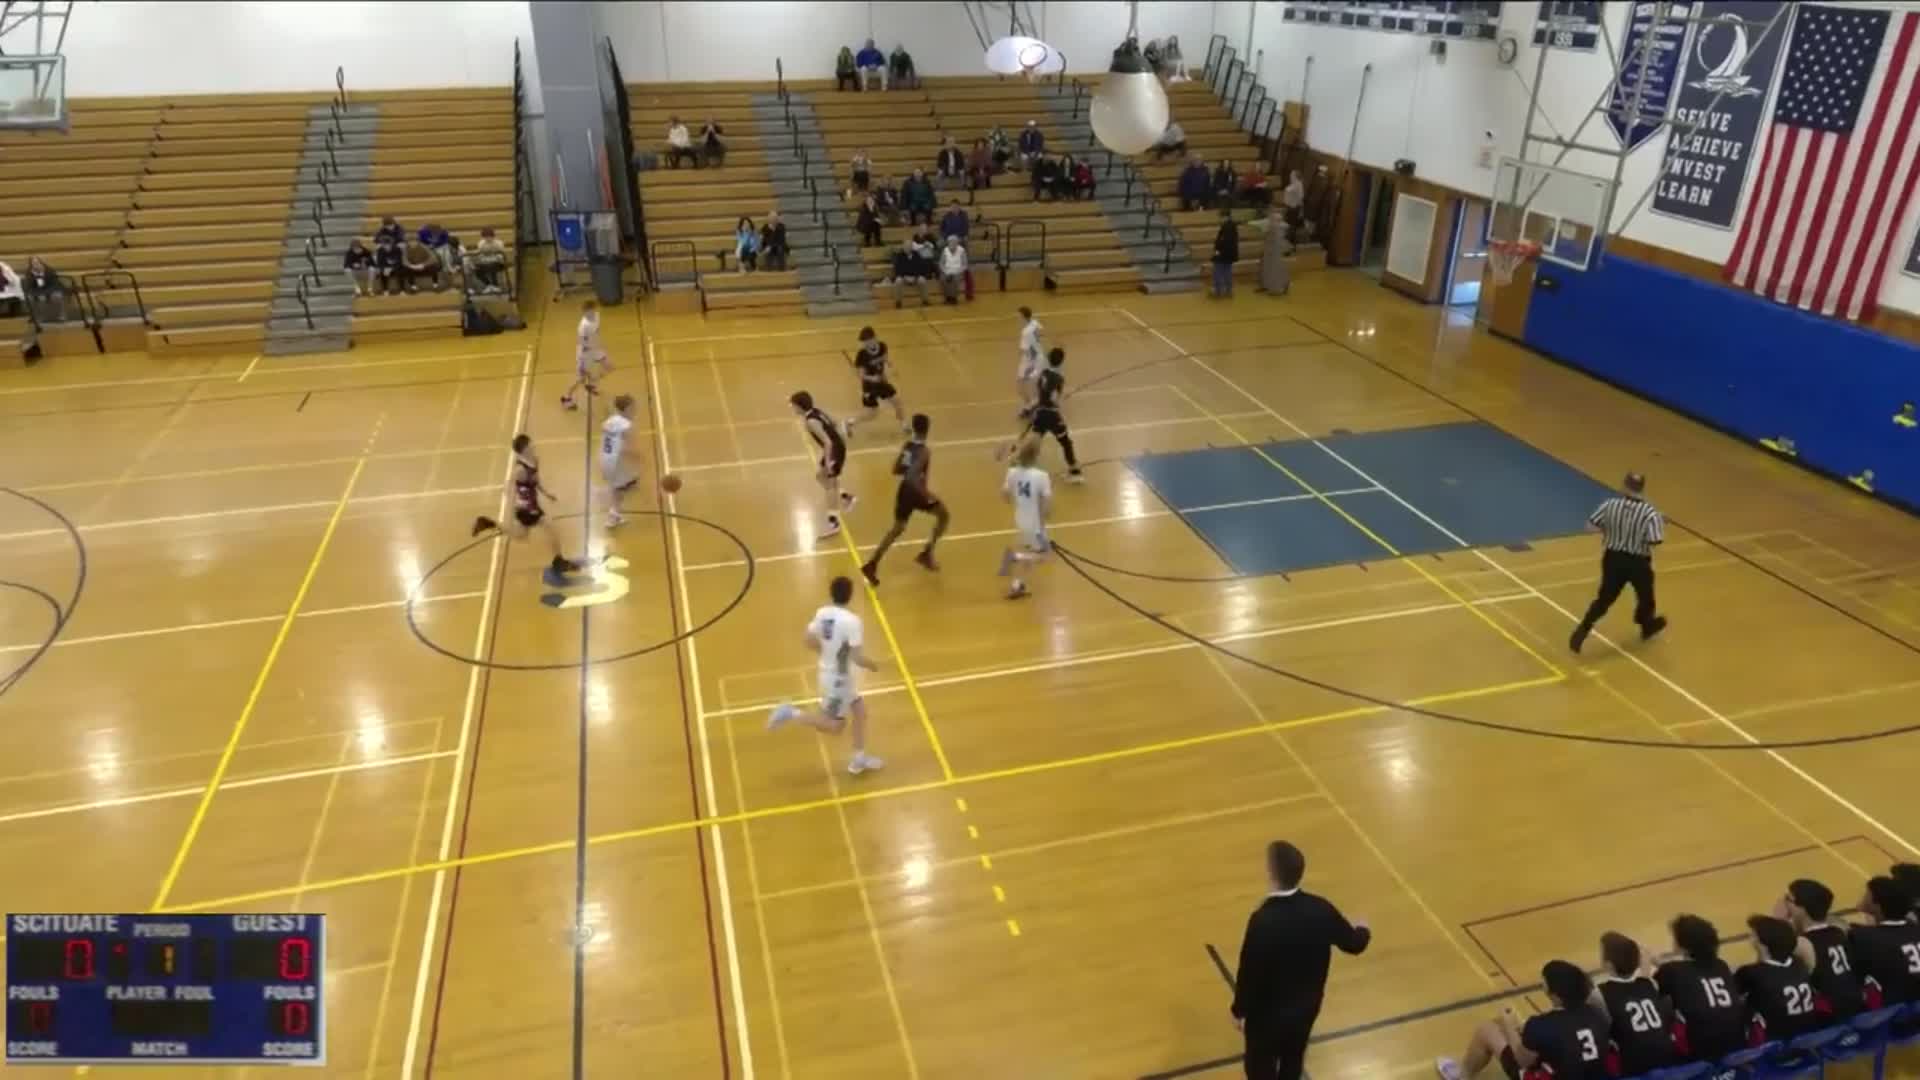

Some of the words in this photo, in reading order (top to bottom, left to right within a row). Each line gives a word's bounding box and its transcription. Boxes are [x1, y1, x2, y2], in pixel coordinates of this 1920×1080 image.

[1677, 107, 1732, 132] SERVE
[1666, 156, 1725, 183] NVEST
[1658, 180, 1712, 206] LEARN
[1828, 945, 1851, 975] 21
[1902, 942, 1920, 973] 3
[1701, 977, 1732, 1008] 15
[1783, 983, 1814, 1015] 22
[1625, 999, 1662, 1032] 20
[1576, 1029, 1599, 1061] 3
